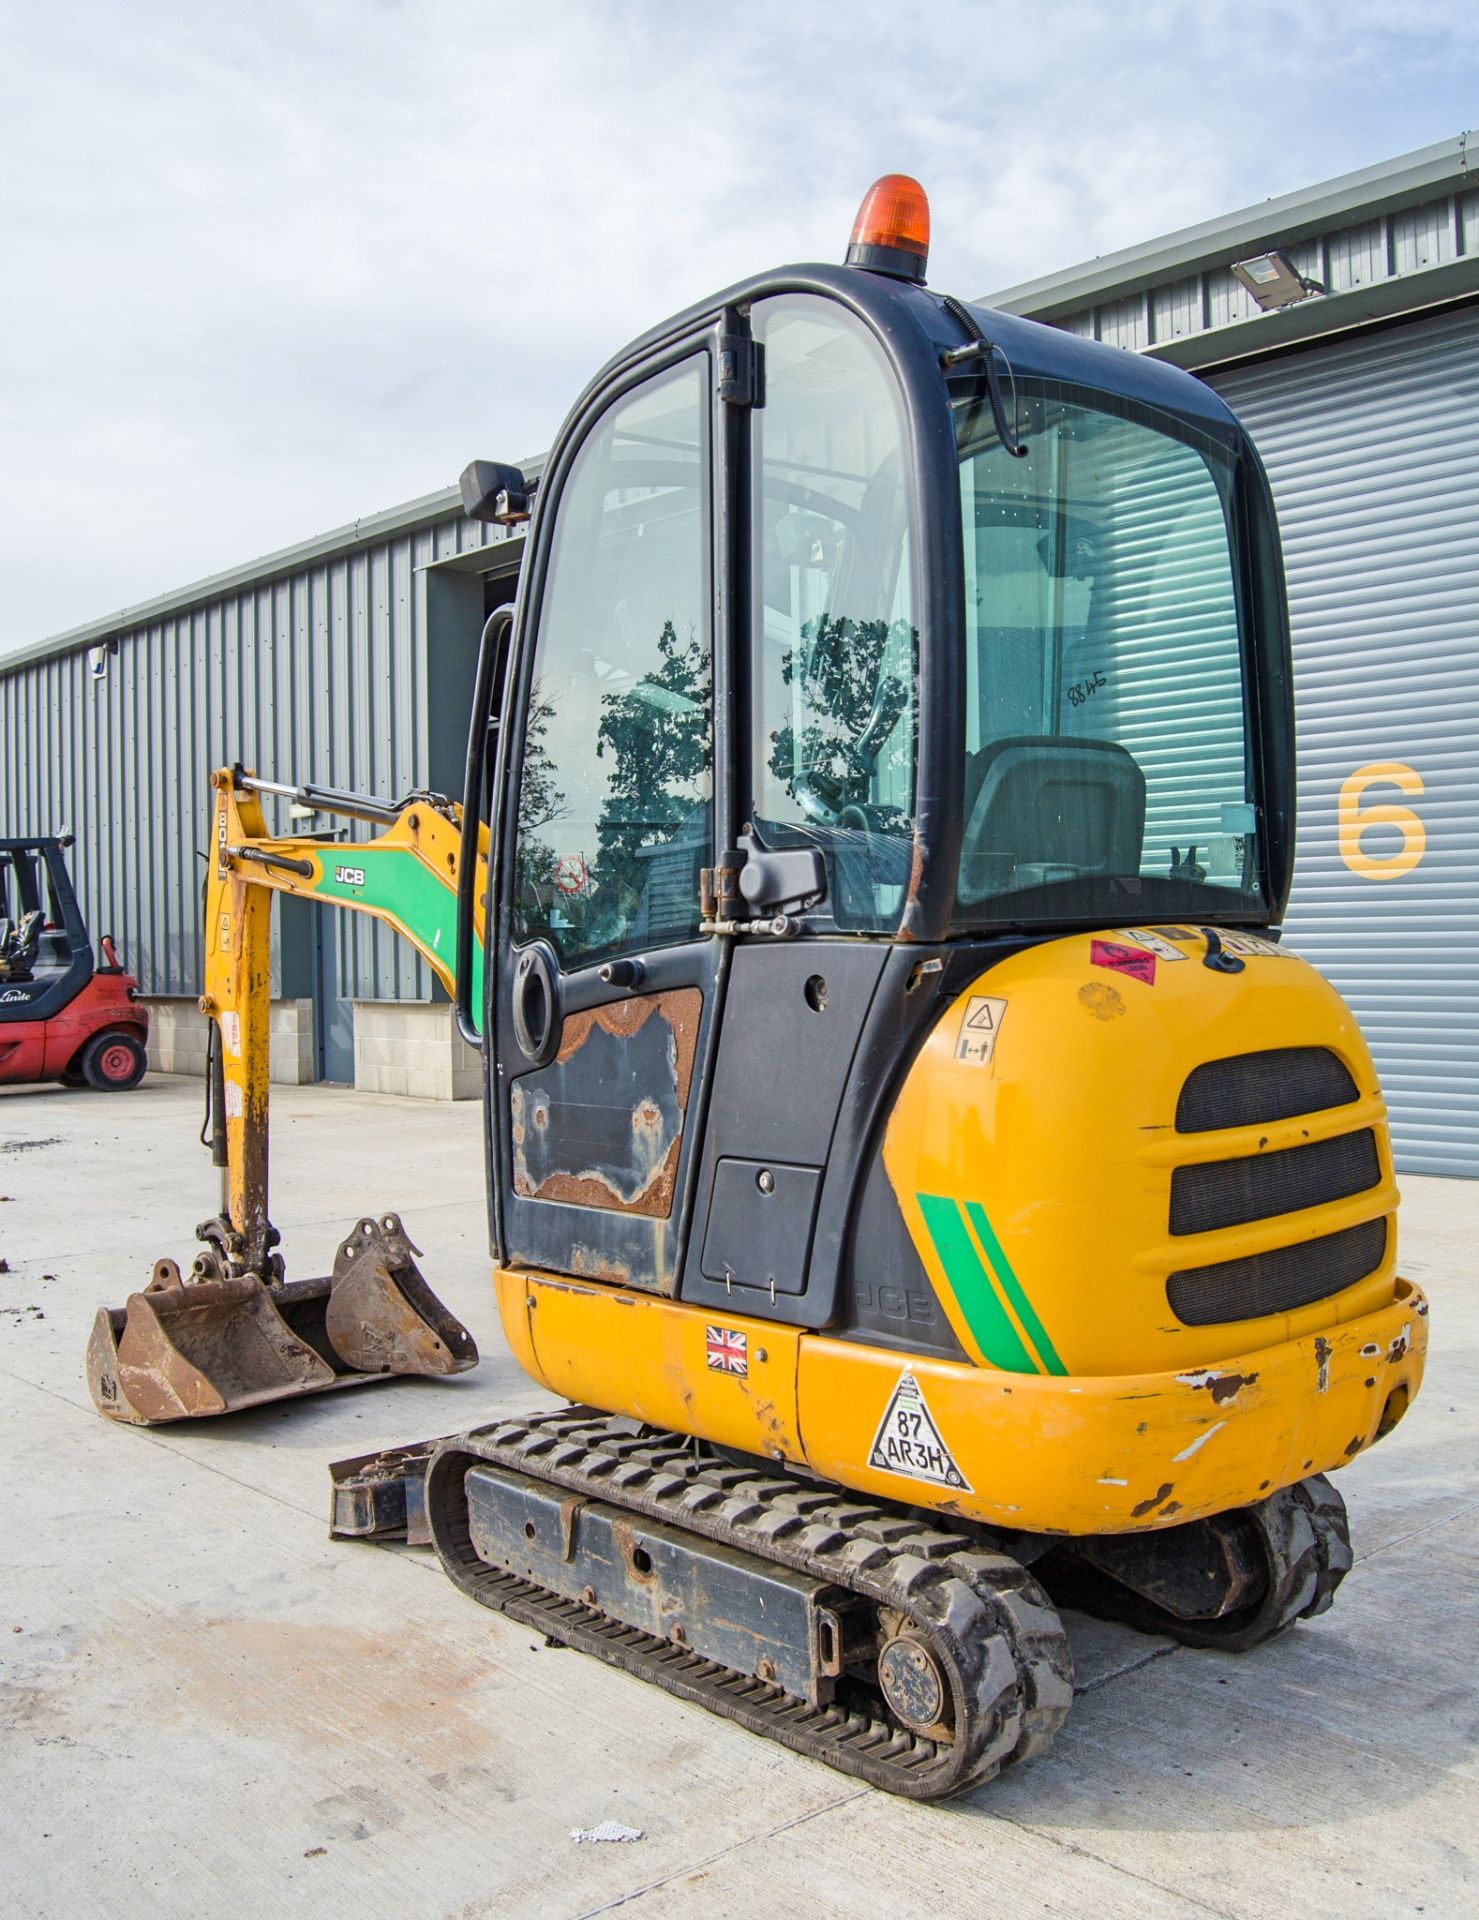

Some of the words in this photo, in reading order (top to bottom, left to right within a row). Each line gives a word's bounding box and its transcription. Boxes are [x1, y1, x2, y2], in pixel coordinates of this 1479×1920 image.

[1067, 670, 1107, 708] 8845
[1338, 762, 1426, 881] 6
[335, 866, 365, 886] JCB
[855, 1281, 937, 1326] JCB
[897, 1410, 922, 1440] 87
[888, 1436, 945, 1474] AR3H
